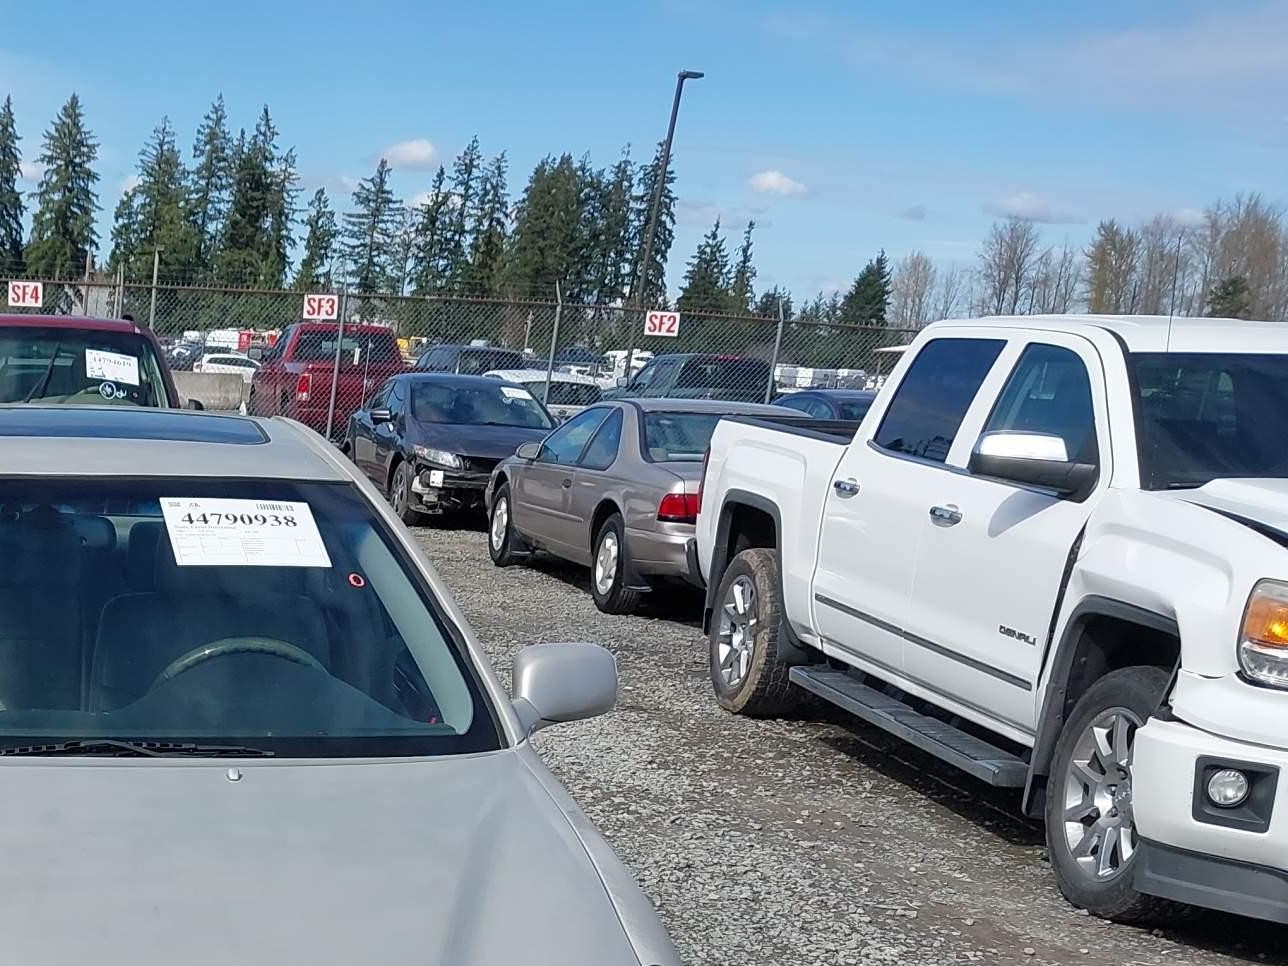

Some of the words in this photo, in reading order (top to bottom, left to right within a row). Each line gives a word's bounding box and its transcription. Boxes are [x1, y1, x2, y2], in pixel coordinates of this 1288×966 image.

[12, 284, 41, 304] SF4
[306, 297, 336, 317] SF3
[647, 313, 677, 333] SF2
[181, 512, 298, 528] 44790938
[998, 624, 1037, 646] DENALI
